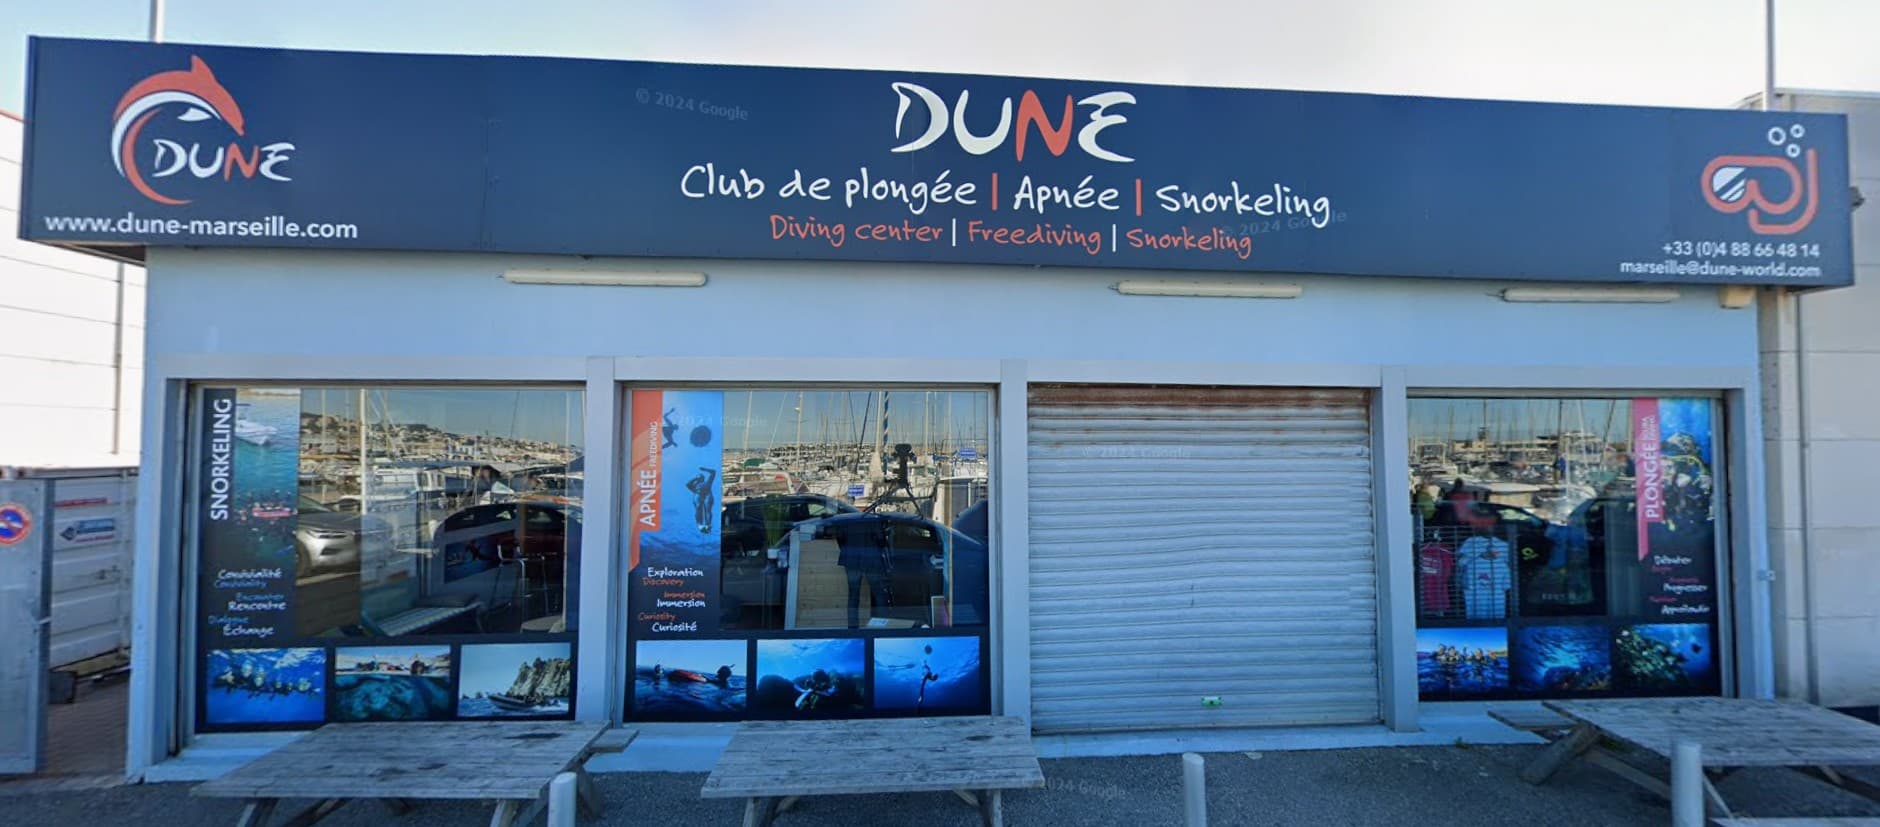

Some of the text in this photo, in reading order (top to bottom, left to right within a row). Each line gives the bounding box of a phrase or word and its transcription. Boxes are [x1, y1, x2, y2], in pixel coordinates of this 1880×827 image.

[891, 82, 1136, 162] DUNE
[153, 138, 295, 182] DUNE
[681, 162, 1330, 228] Club de plongée Apnée Snorkeling
[45, 213, 358, 240] www.dune-marseille.com
[770, 214, 1251, 260] Diving center Freediving Snorkeling
[1620, 260, 1821, 278] marseille@dune-world.com
[1662, 241, 1820, 258] +33 (0)4 88 66 48 14
[210, 398, 232, 521] SNORKELING
[1641, 440, 1660, 519] PLONGÉE
[637, 469, 657, 527] APNÉE
[647, 566, 705, 579] Exploration
[657, 598, 706, 608] Immersion
[651, 621, 697, 633] Curiosité
